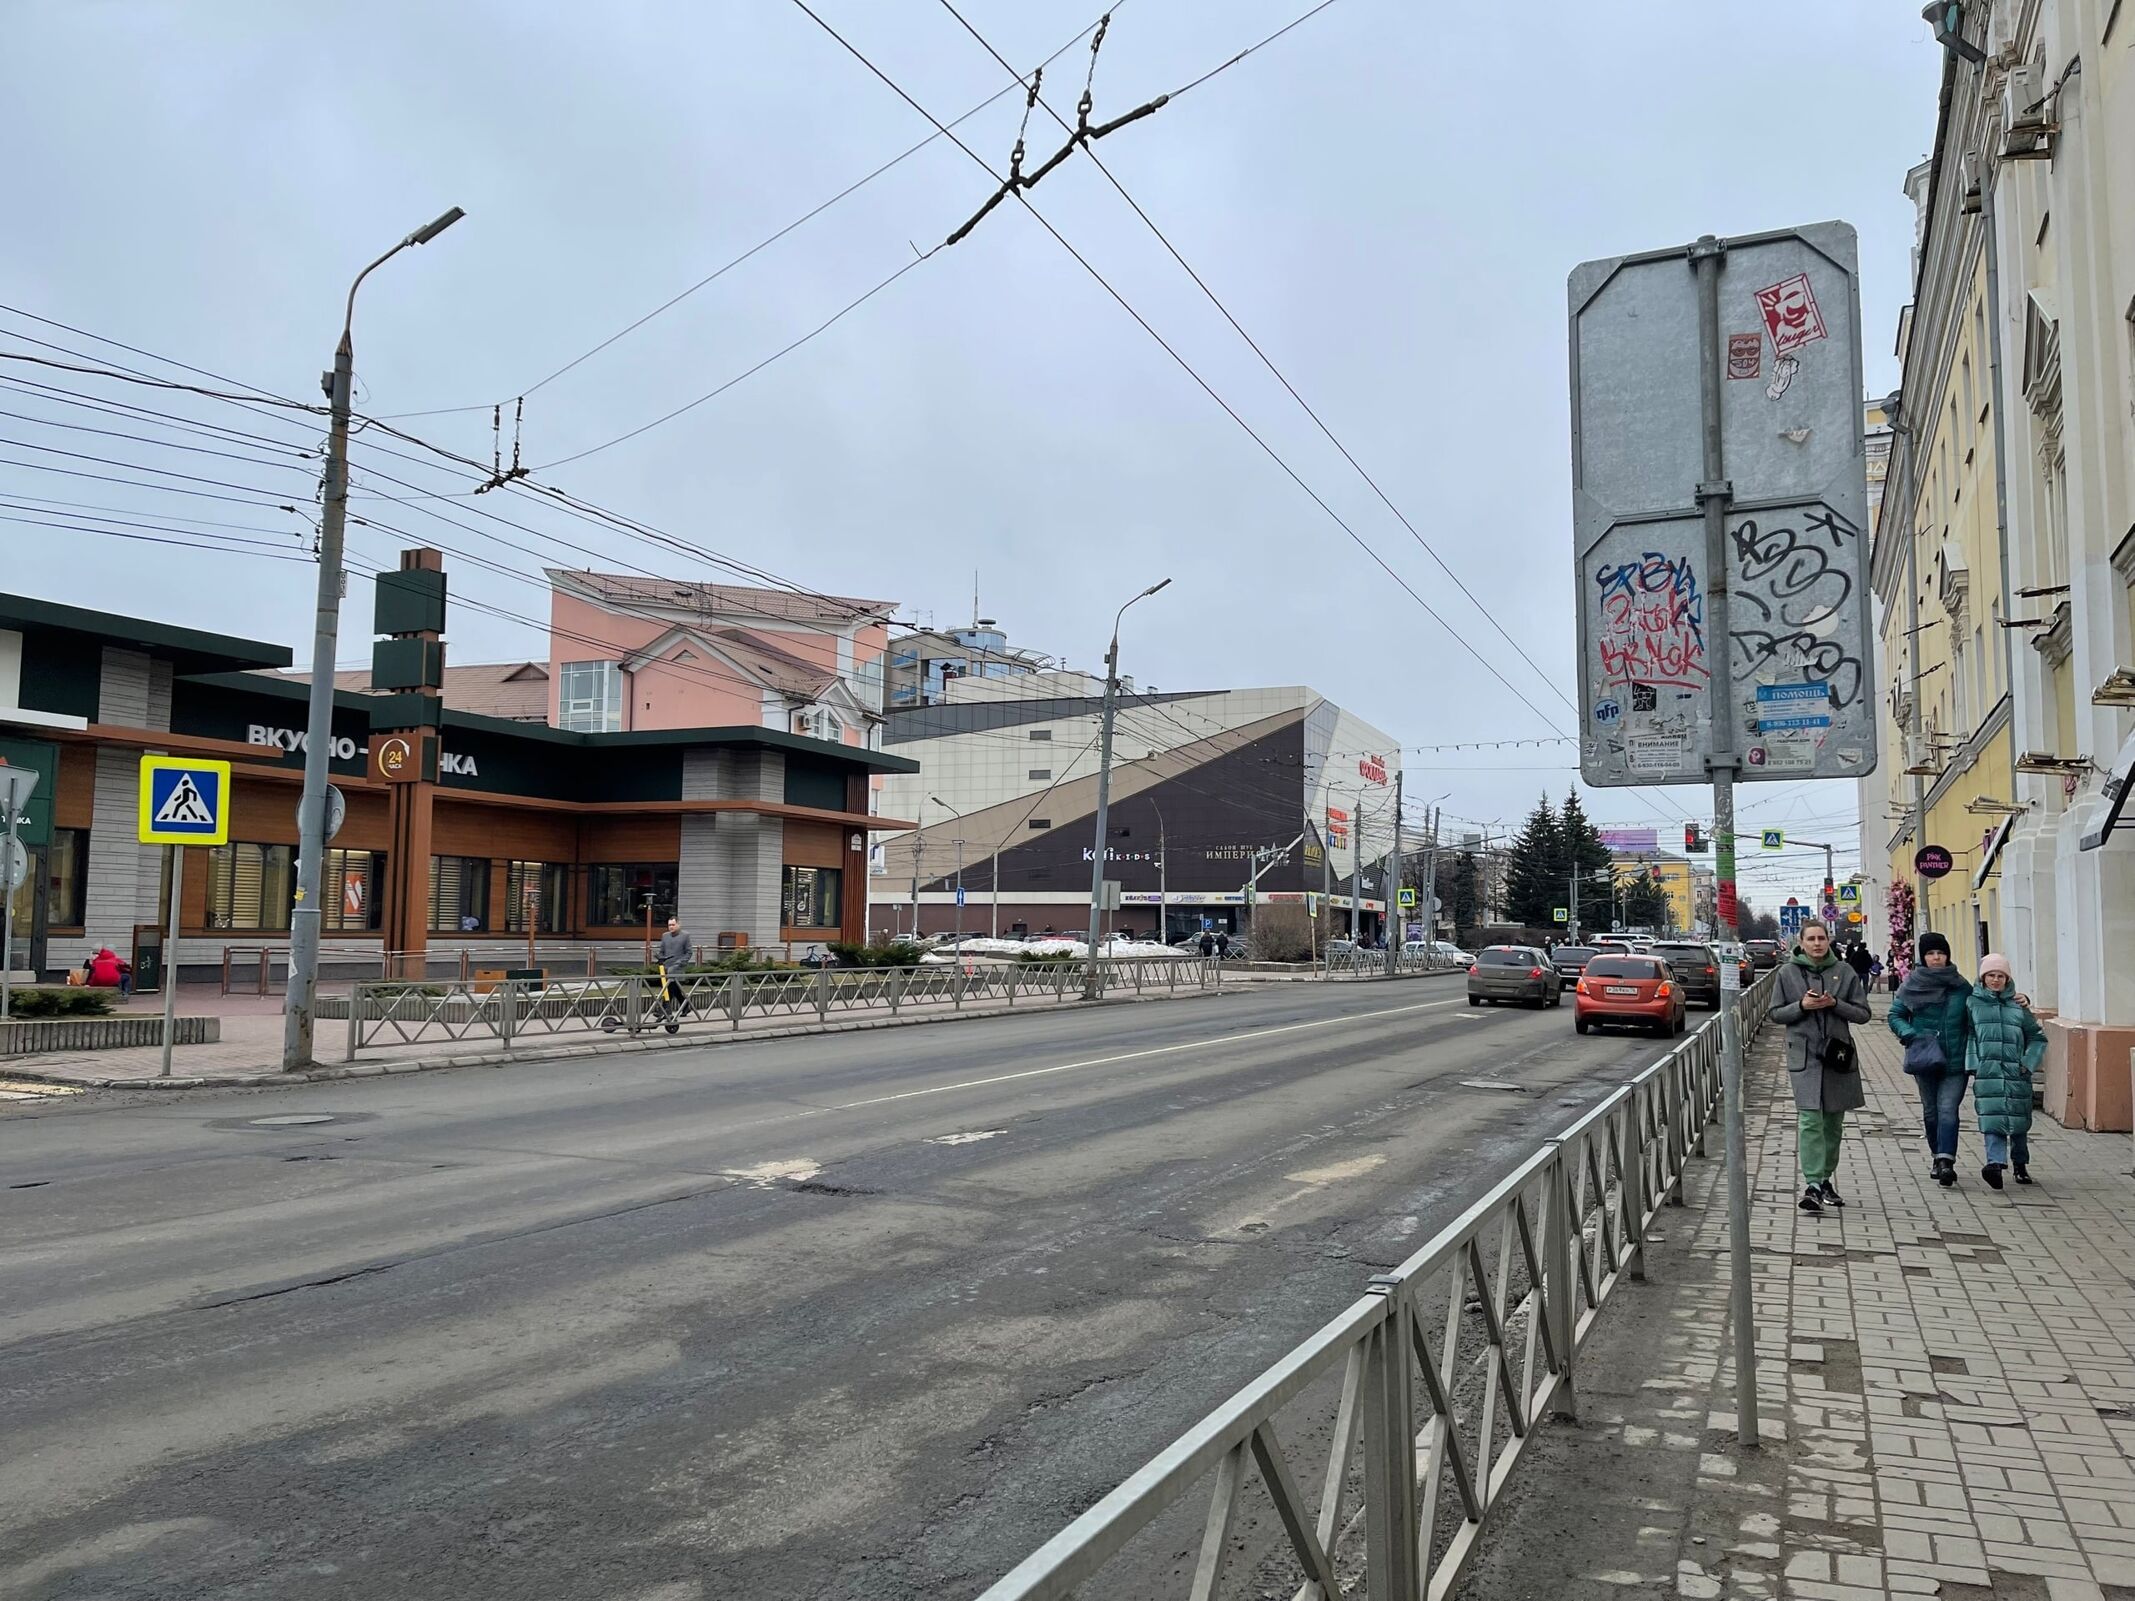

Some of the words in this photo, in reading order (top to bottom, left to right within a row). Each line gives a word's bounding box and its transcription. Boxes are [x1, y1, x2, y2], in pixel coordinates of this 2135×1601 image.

[1771, 688, 1825, 700] ПОМОЩЬ
[389, 751, 402, 764] 24
[1926, 852, 1941, 860] PINK
[1920, 861, 1950, 869] PANTHER
